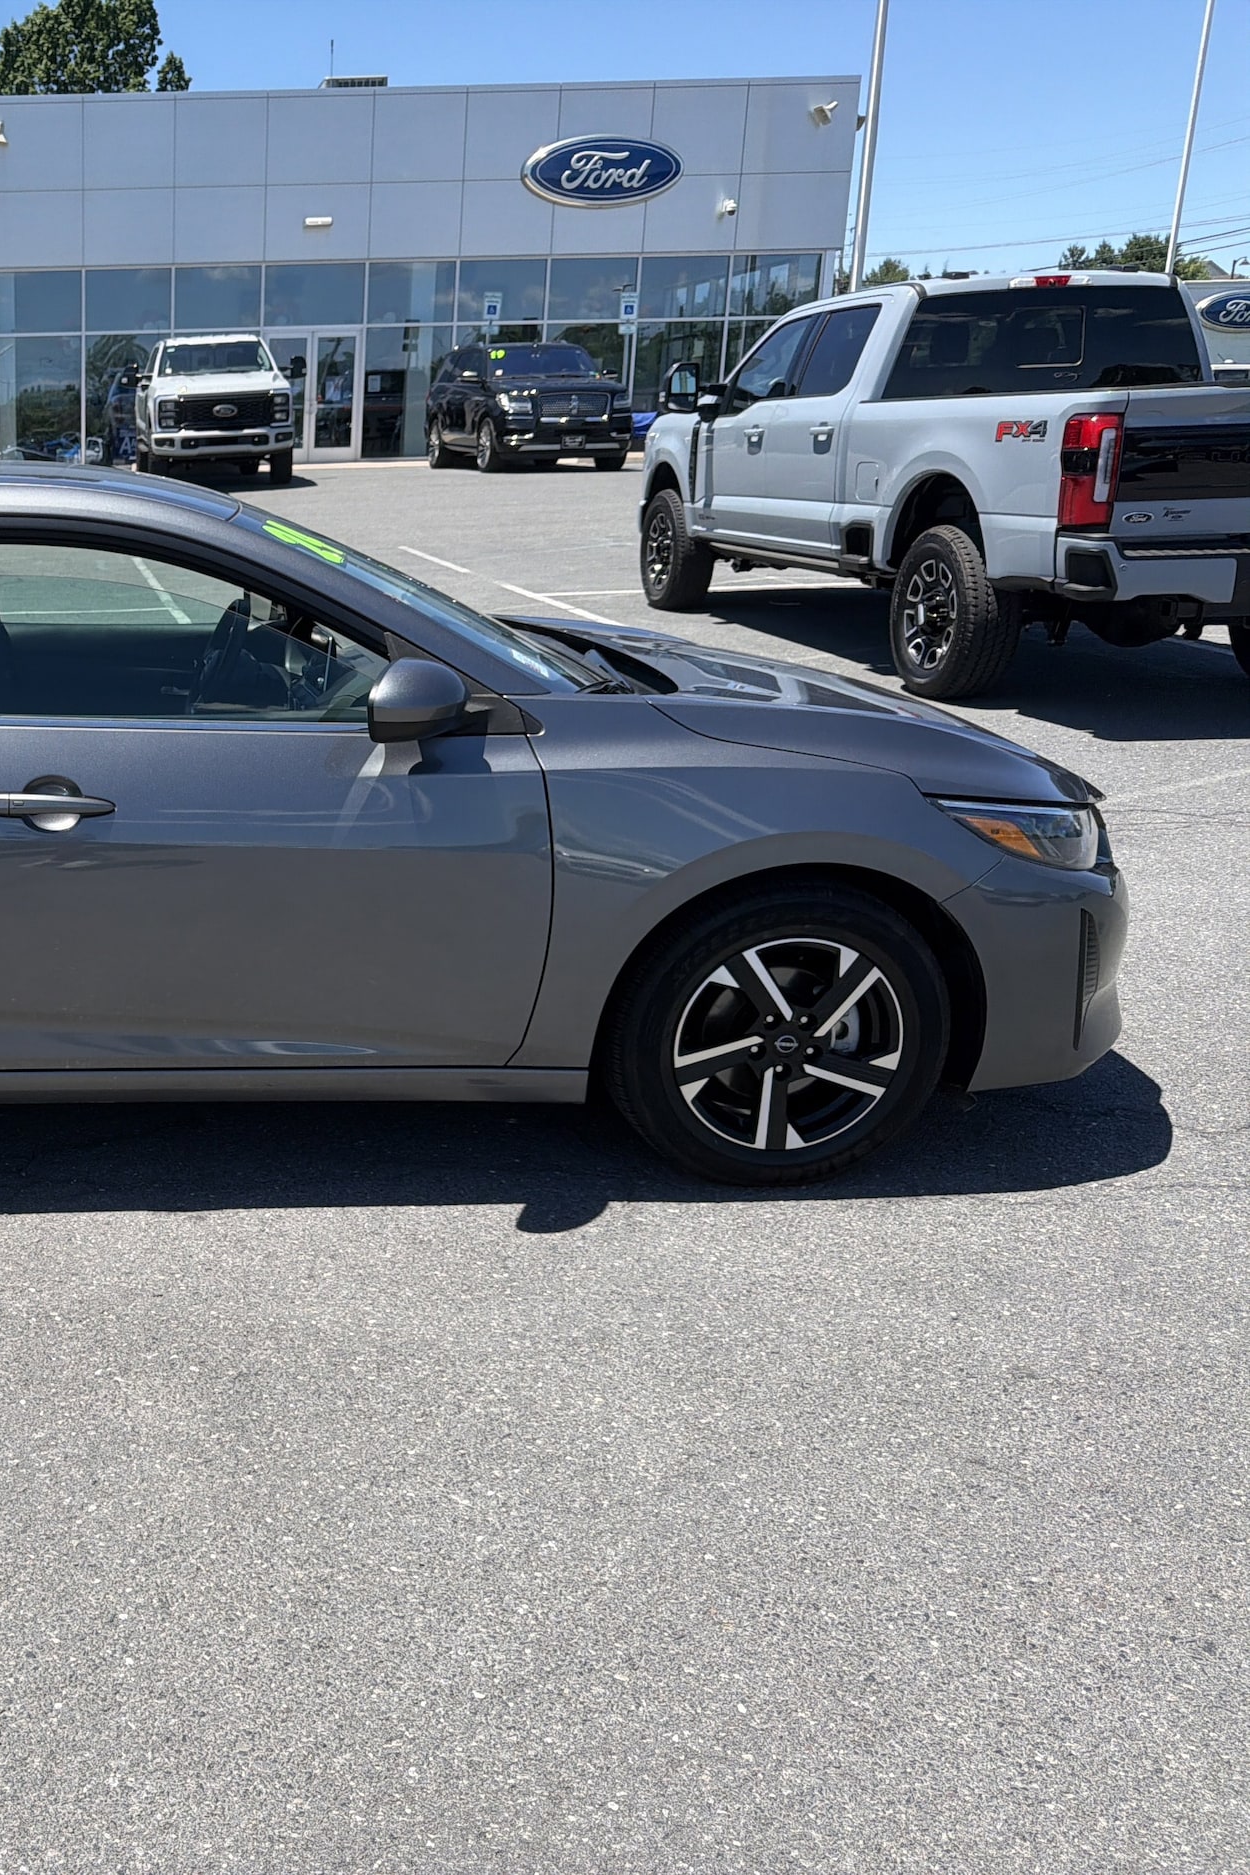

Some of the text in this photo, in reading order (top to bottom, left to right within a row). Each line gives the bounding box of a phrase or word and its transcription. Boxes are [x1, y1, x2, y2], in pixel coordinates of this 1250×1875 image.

[561, 151, 651, 189] Ford
[1219, 300, 1250, 322] Fo
[995, 420, 1048, 442] FX4
